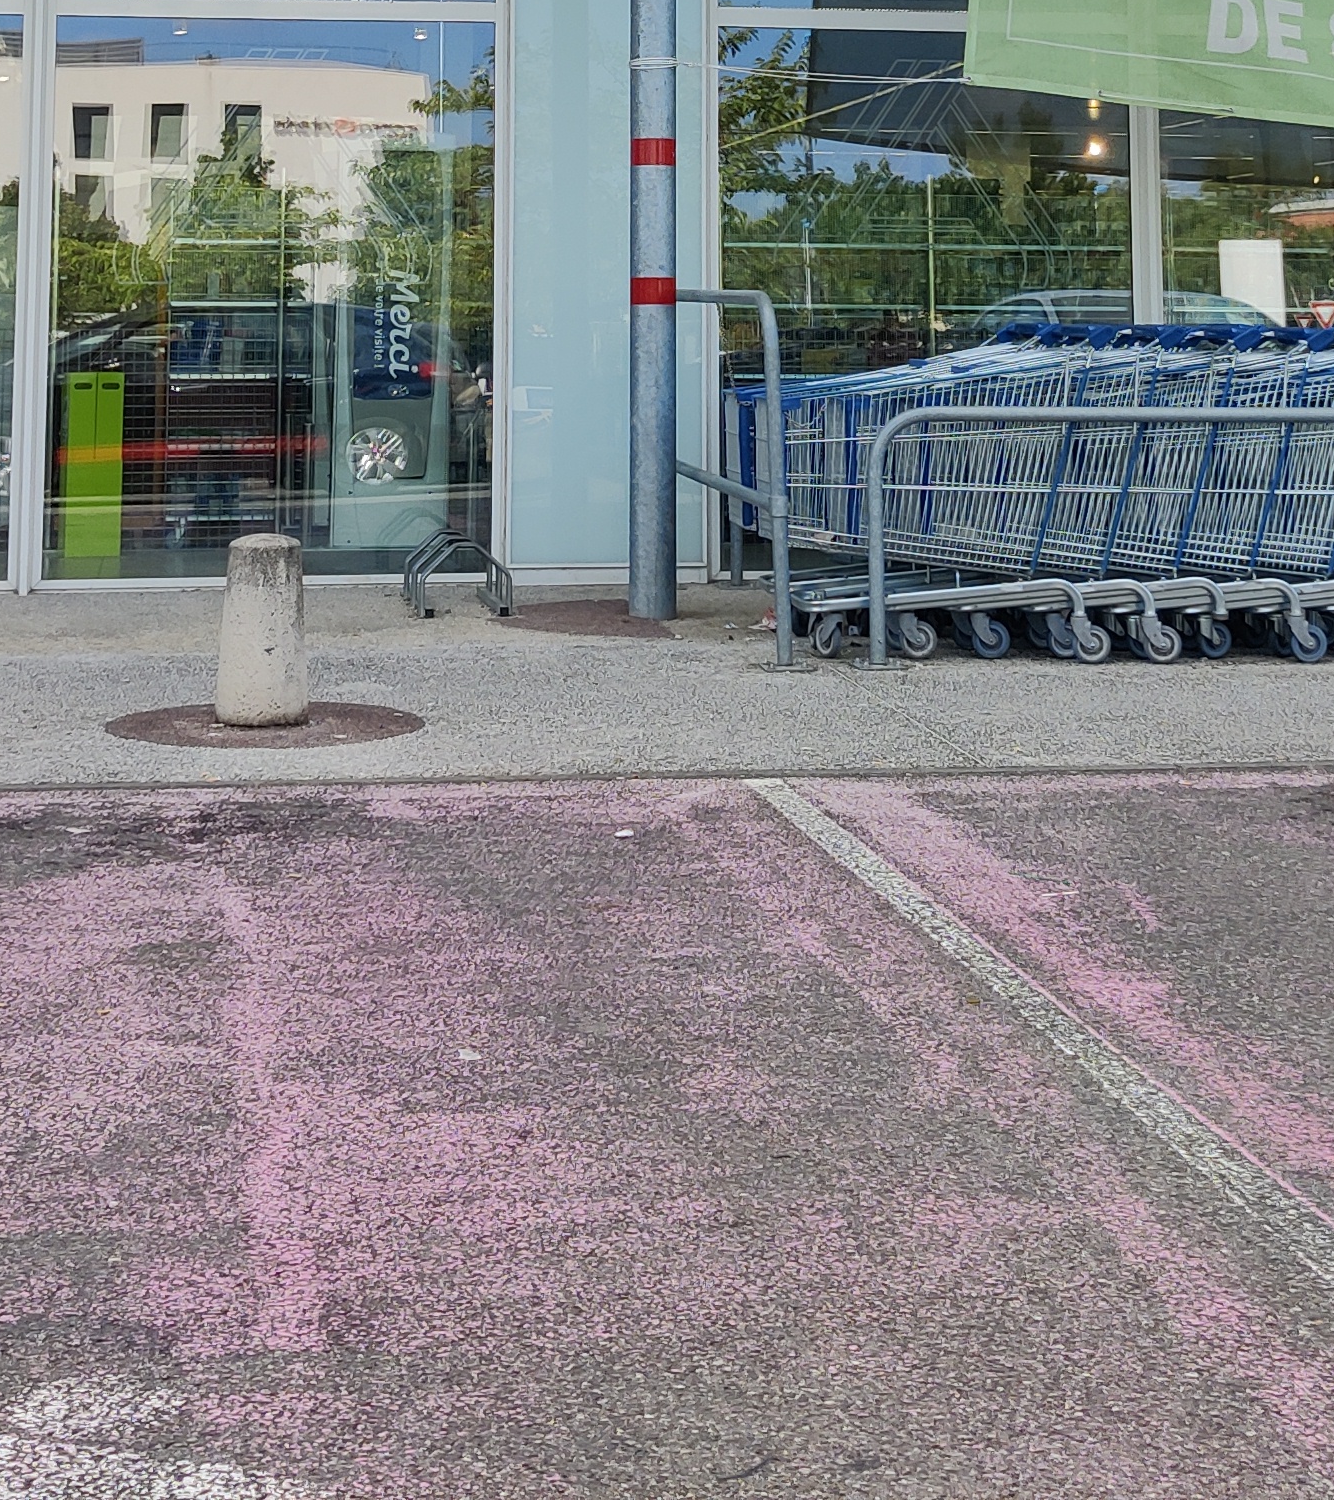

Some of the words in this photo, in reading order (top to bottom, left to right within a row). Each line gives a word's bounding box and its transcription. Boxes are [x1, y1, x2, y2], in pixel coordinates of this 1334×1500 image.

[373, 295, 385, 327] votre
[389, 269, 421, 380] Merci
[373, 328, 386, 361] visite
